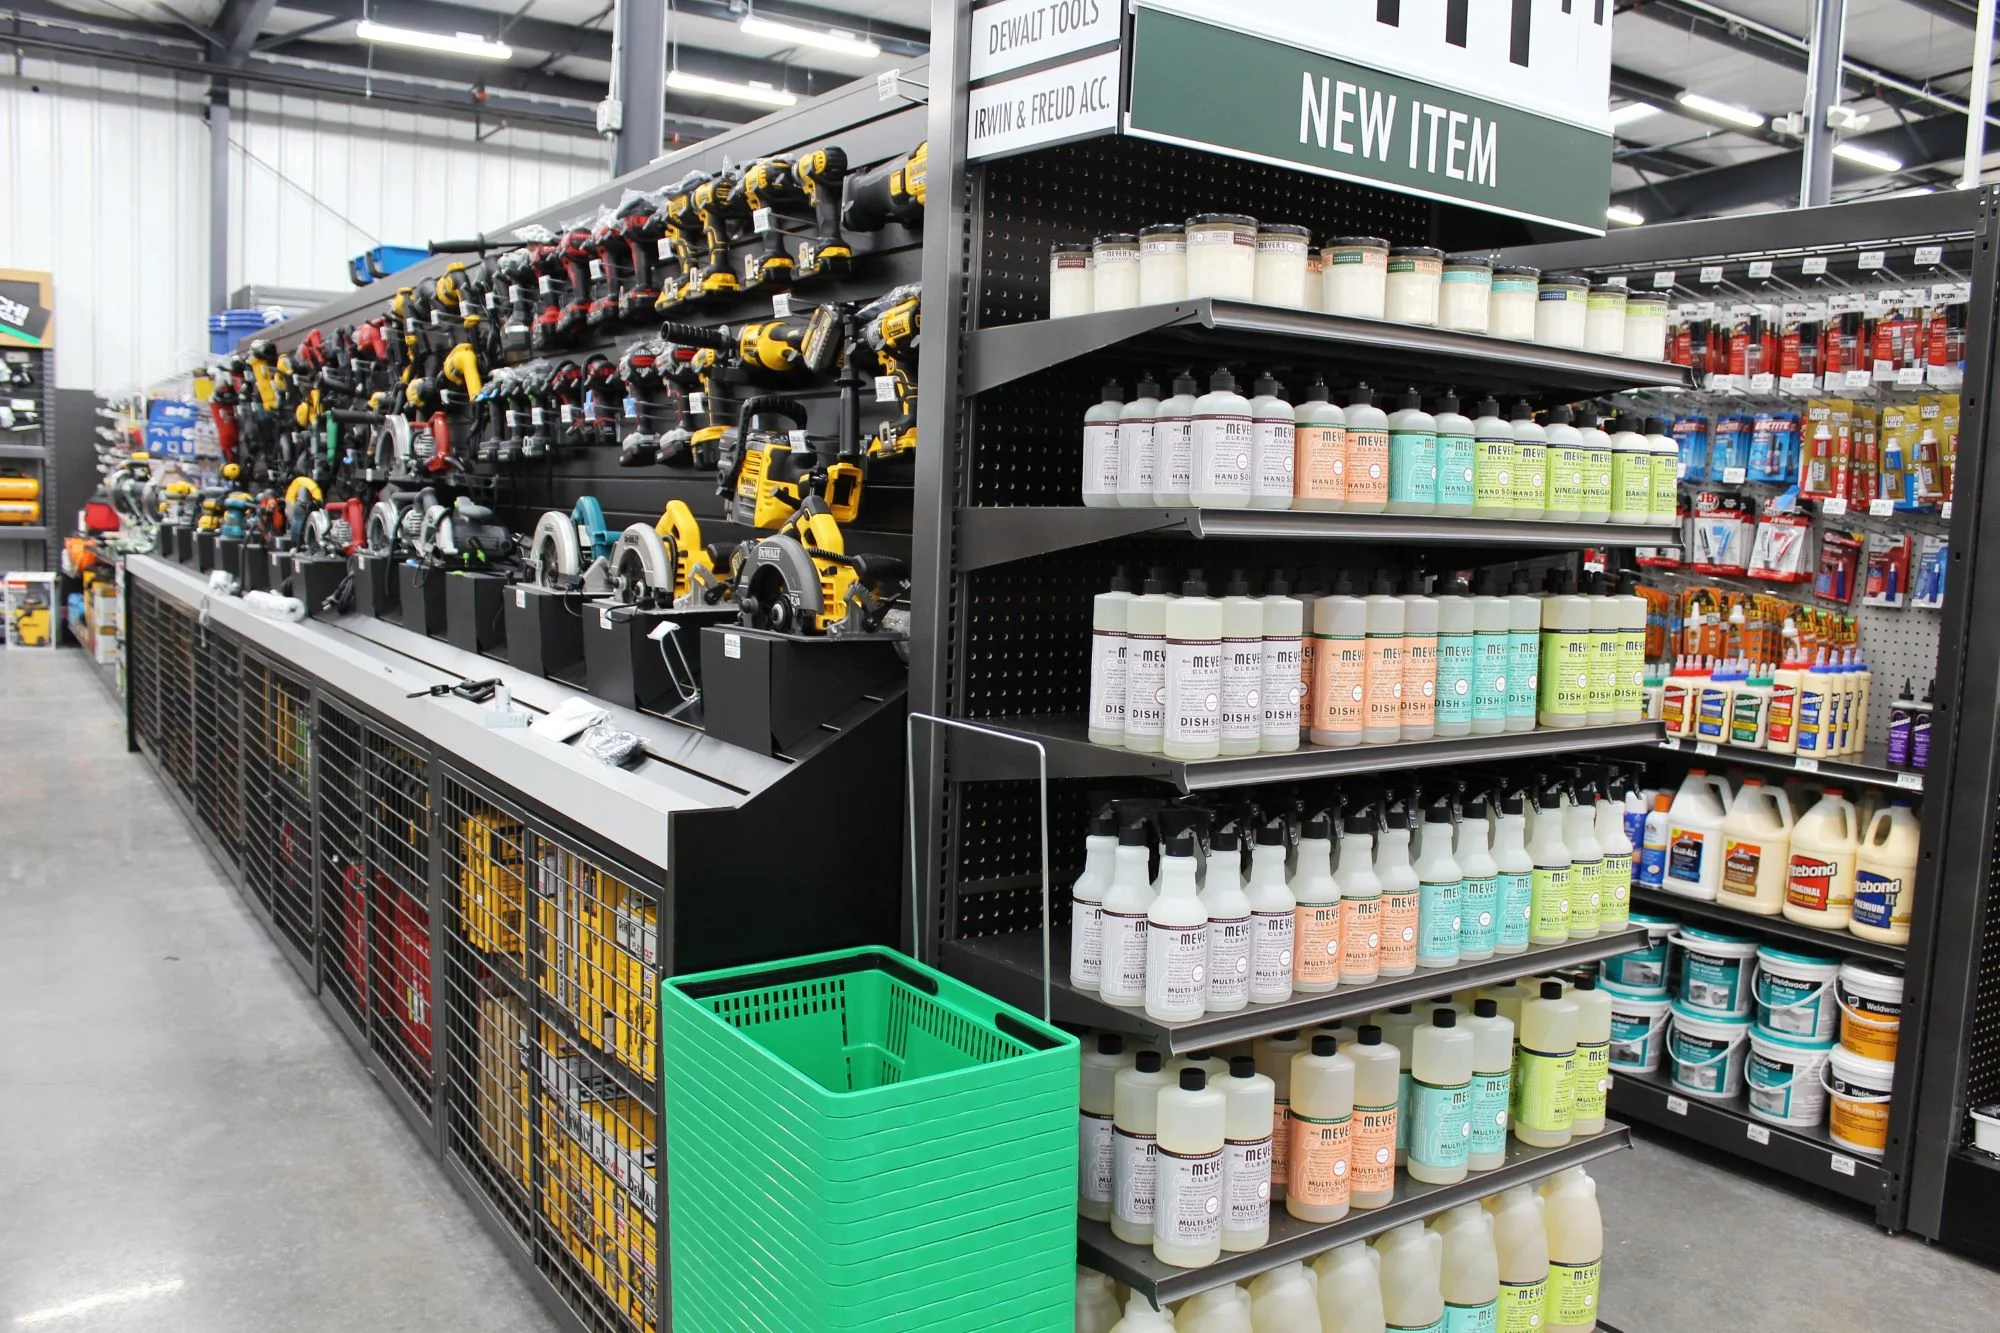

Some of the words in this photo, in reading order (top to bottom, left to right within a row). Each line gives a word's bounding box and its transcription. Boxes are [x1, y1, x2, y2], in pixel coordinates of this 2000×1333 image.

[989, 8, 1045, 55] DEWALT
[1050, 0, 1099, 36] TOOLS
[975, 101, 1012, 139] IRWIN
[1016, 100, 1026, 129] &
[1032, 86, 1074, 126] FREUD
[1080, 76, 1110, 114] ACC.
[1300, 71, 1398, 163] NEW
[1408, 101, 1497, 188] ITEM
[1809, 408, 1830, 416] LIQUID
[1921, 405, 1940, 413] LIQUID
[1885, 415, 1904, 423] LIQUID
[1509, 694, 1532, 702] DISH
[1558, 692, 1581, 700] DISH
[1401, 701, 1425, 710] DISH
[1435, 699, 1460, 708] DISH
[1476, 697, 1499, 705] DISH
[1330, 707, 1355, 715] DISH
[1371, 704, 1396, 713] DISH
[1132, 710, 1159, 719] DISH
[1223, 713, 1250, 722] DISH
[1266, 710, 1292, 719] DISH
[1181, 717, 1209, 726] DISH
[1855, 899, 1885, 913] PREMIUM
[1772, 977, 1810, 990] Weldwood
